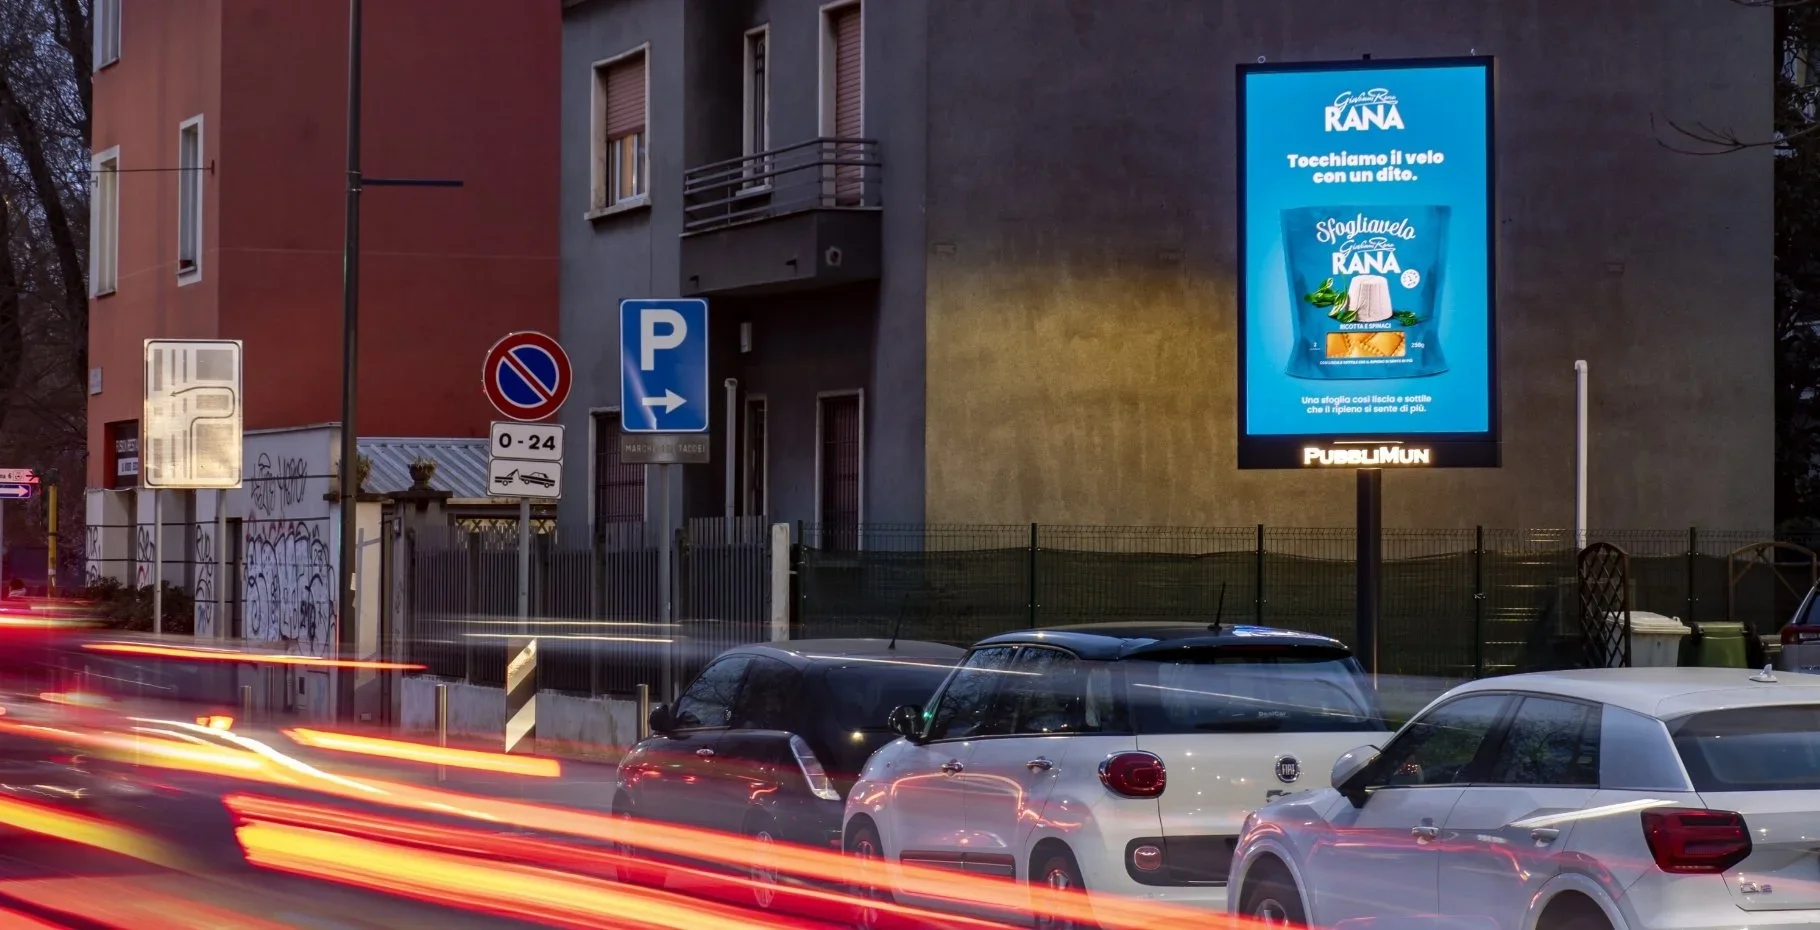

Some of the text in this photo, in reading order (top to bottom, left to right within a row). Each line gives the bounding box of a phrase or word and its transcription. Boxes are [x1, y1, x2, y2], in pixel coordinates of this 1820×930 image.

[1325, 104, 1405, 132] RANA
[1287, 149, 1445, 168] Tocchiamo il velo
[1312, 166, 1418, 184] con un dito.
[1316, 213, 1416, 245] Sfogliavelo
[1332, 251, 1401, 275] RANA
[640, 308, 688, 371] P
[1301, 396, 1320, 404] Una
[1321, 395, 1351, 406] sfoglia
[1372, 394, 1396, 403] liscia
[1405, 394, 1432, 403] sottile
[1307, 405, 1323, 413] che
[1325, 405, 1331, 413] il
[1332, 404, 1363, 415] ripieno
[1364, 404, 1372, 413] si
[1373, 404, 1398, 413] sente
[1400, 403, 1409, 412] di
[499, 433, 512, 448] 0
[528, 434, 556, 450] 24
[1281, 763, 1296, 776] FIAT
